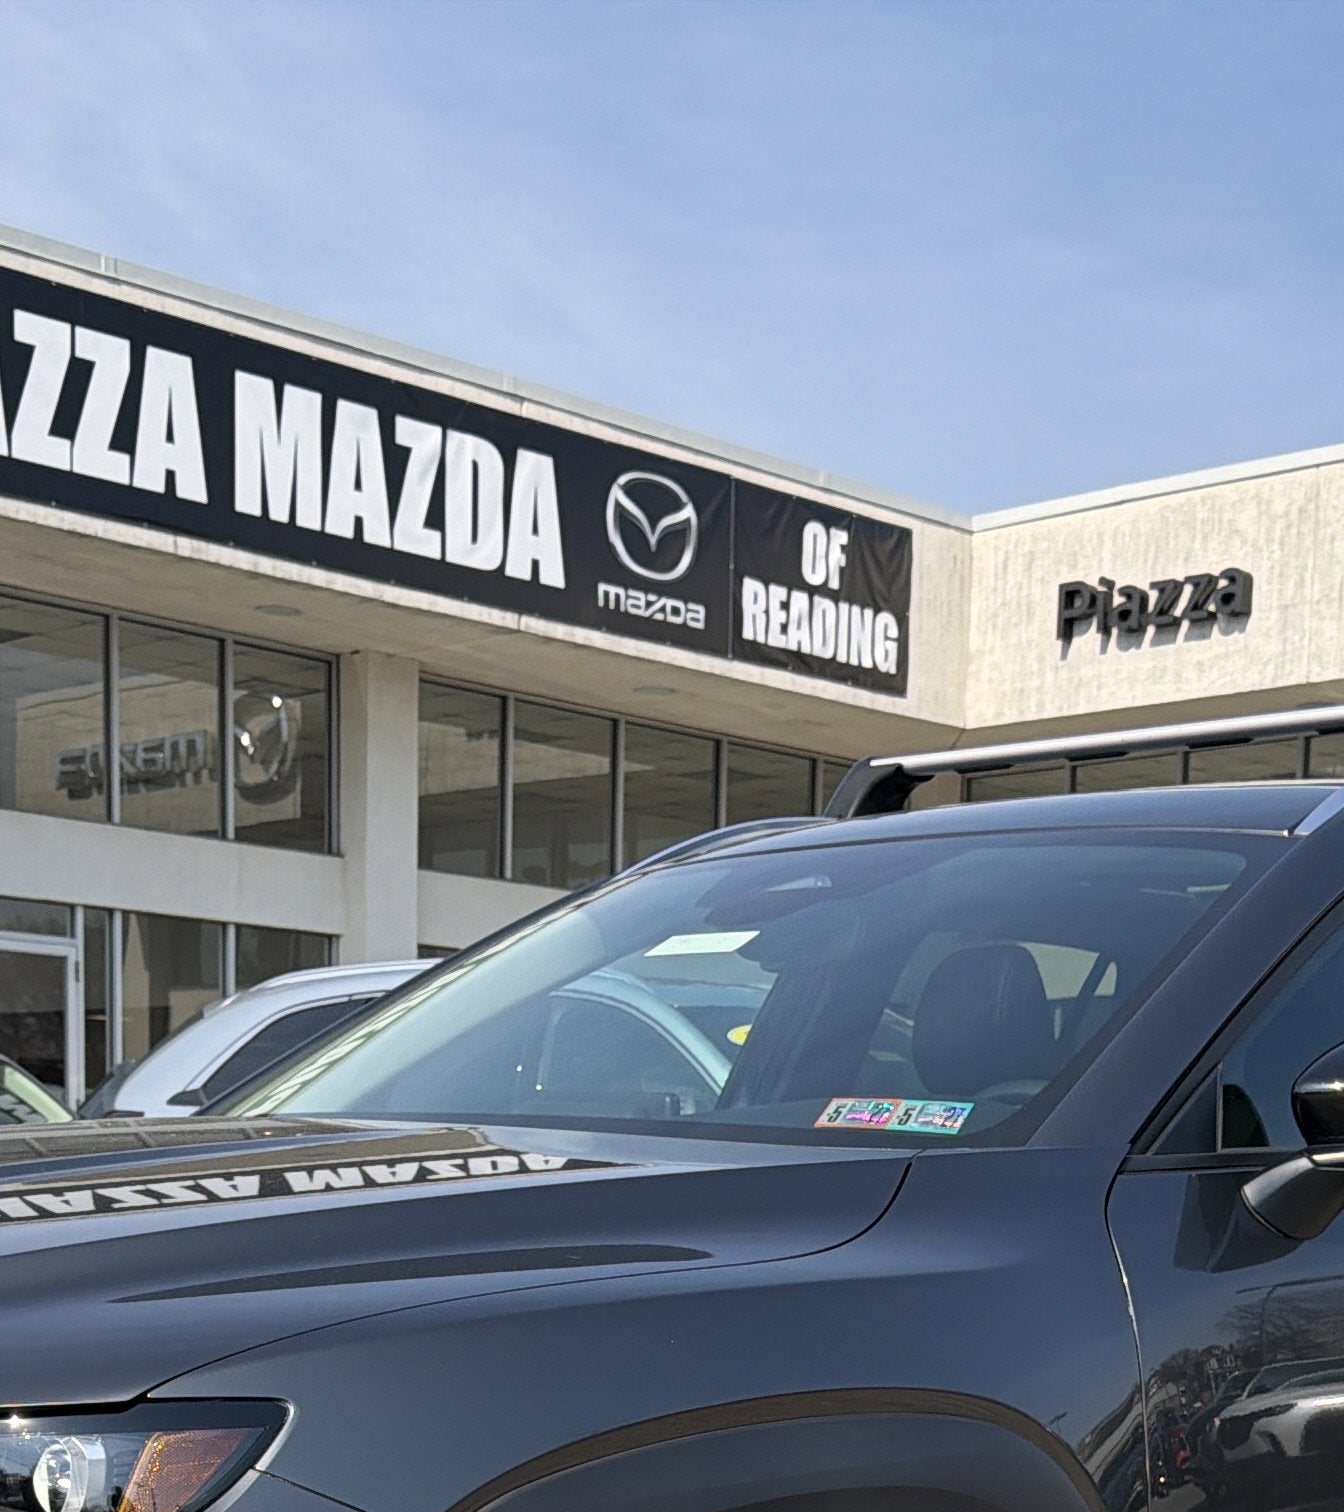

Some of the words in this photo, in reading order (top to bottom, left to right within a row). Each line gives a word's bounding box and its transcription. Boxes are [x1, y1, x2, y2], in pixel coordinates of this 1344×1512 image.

[234, 369, 565, 589] MAZDA
[802, 520, 849, 590] OF
[597, 582, 706, 630] mazda
[741, 576, 899, 674] READING
[1057, 567, 1253, 641] Piazza
